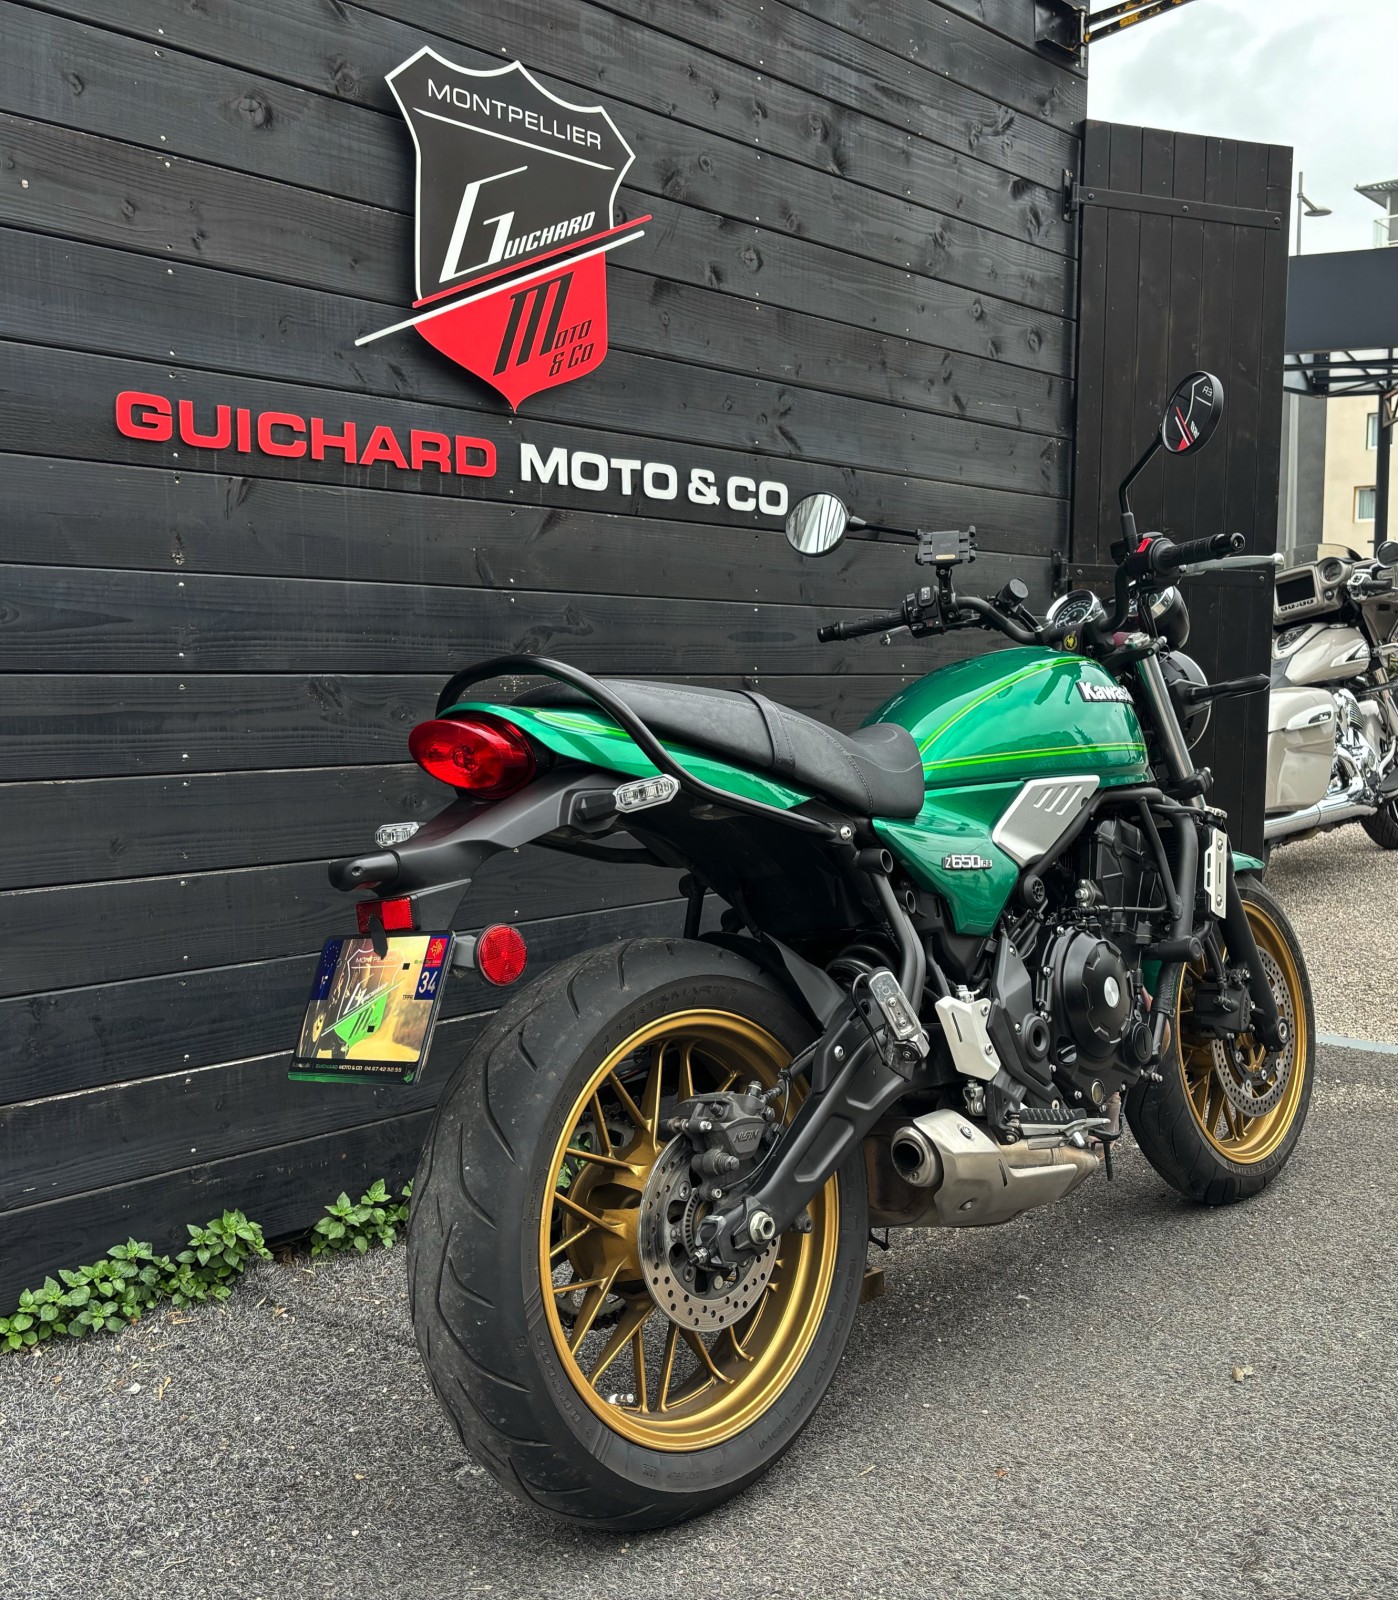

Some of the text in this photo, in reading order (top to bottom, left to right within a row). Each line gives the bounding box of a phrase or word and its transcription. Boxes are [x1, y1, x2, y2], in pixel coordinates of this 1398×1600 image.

[427, 78, 601, 151] MONTPELLIER
[438, 165, 596, 284] GUICHARD
[492, 270, 592, 376] MOTO
[115, 390, 789, 516] GUICHARD MOTO & CO
[418, 970, 438, 994] 34
